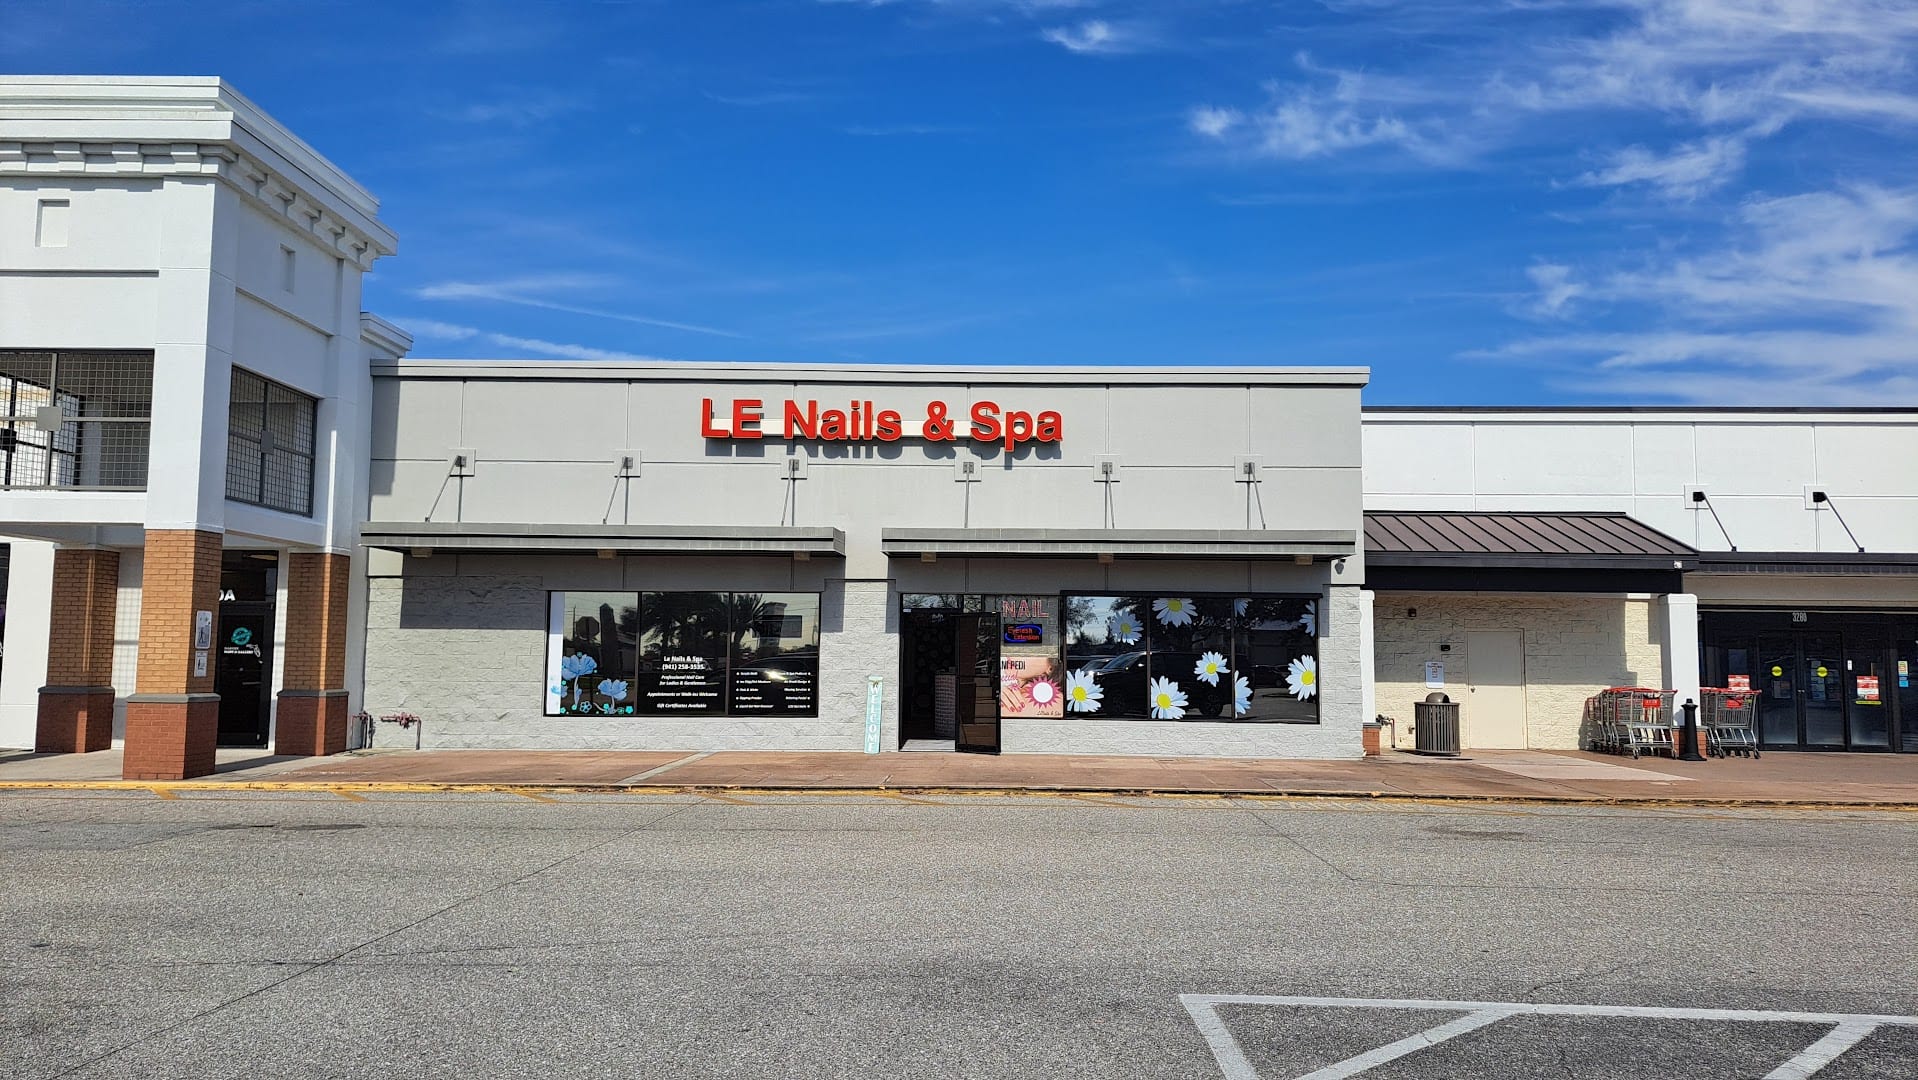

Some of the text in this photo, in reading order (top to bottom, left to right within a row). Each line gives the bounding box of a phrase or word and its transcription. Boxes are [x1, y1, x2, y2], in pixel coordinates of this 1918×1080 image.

[702, 399, 1062, 452] LE Nails & Spa
[1002, 599, 1049, 618] NAIL
[1010, 660, 1026, 670] PEDI
[868, 685, 880, 752] WELCOME
